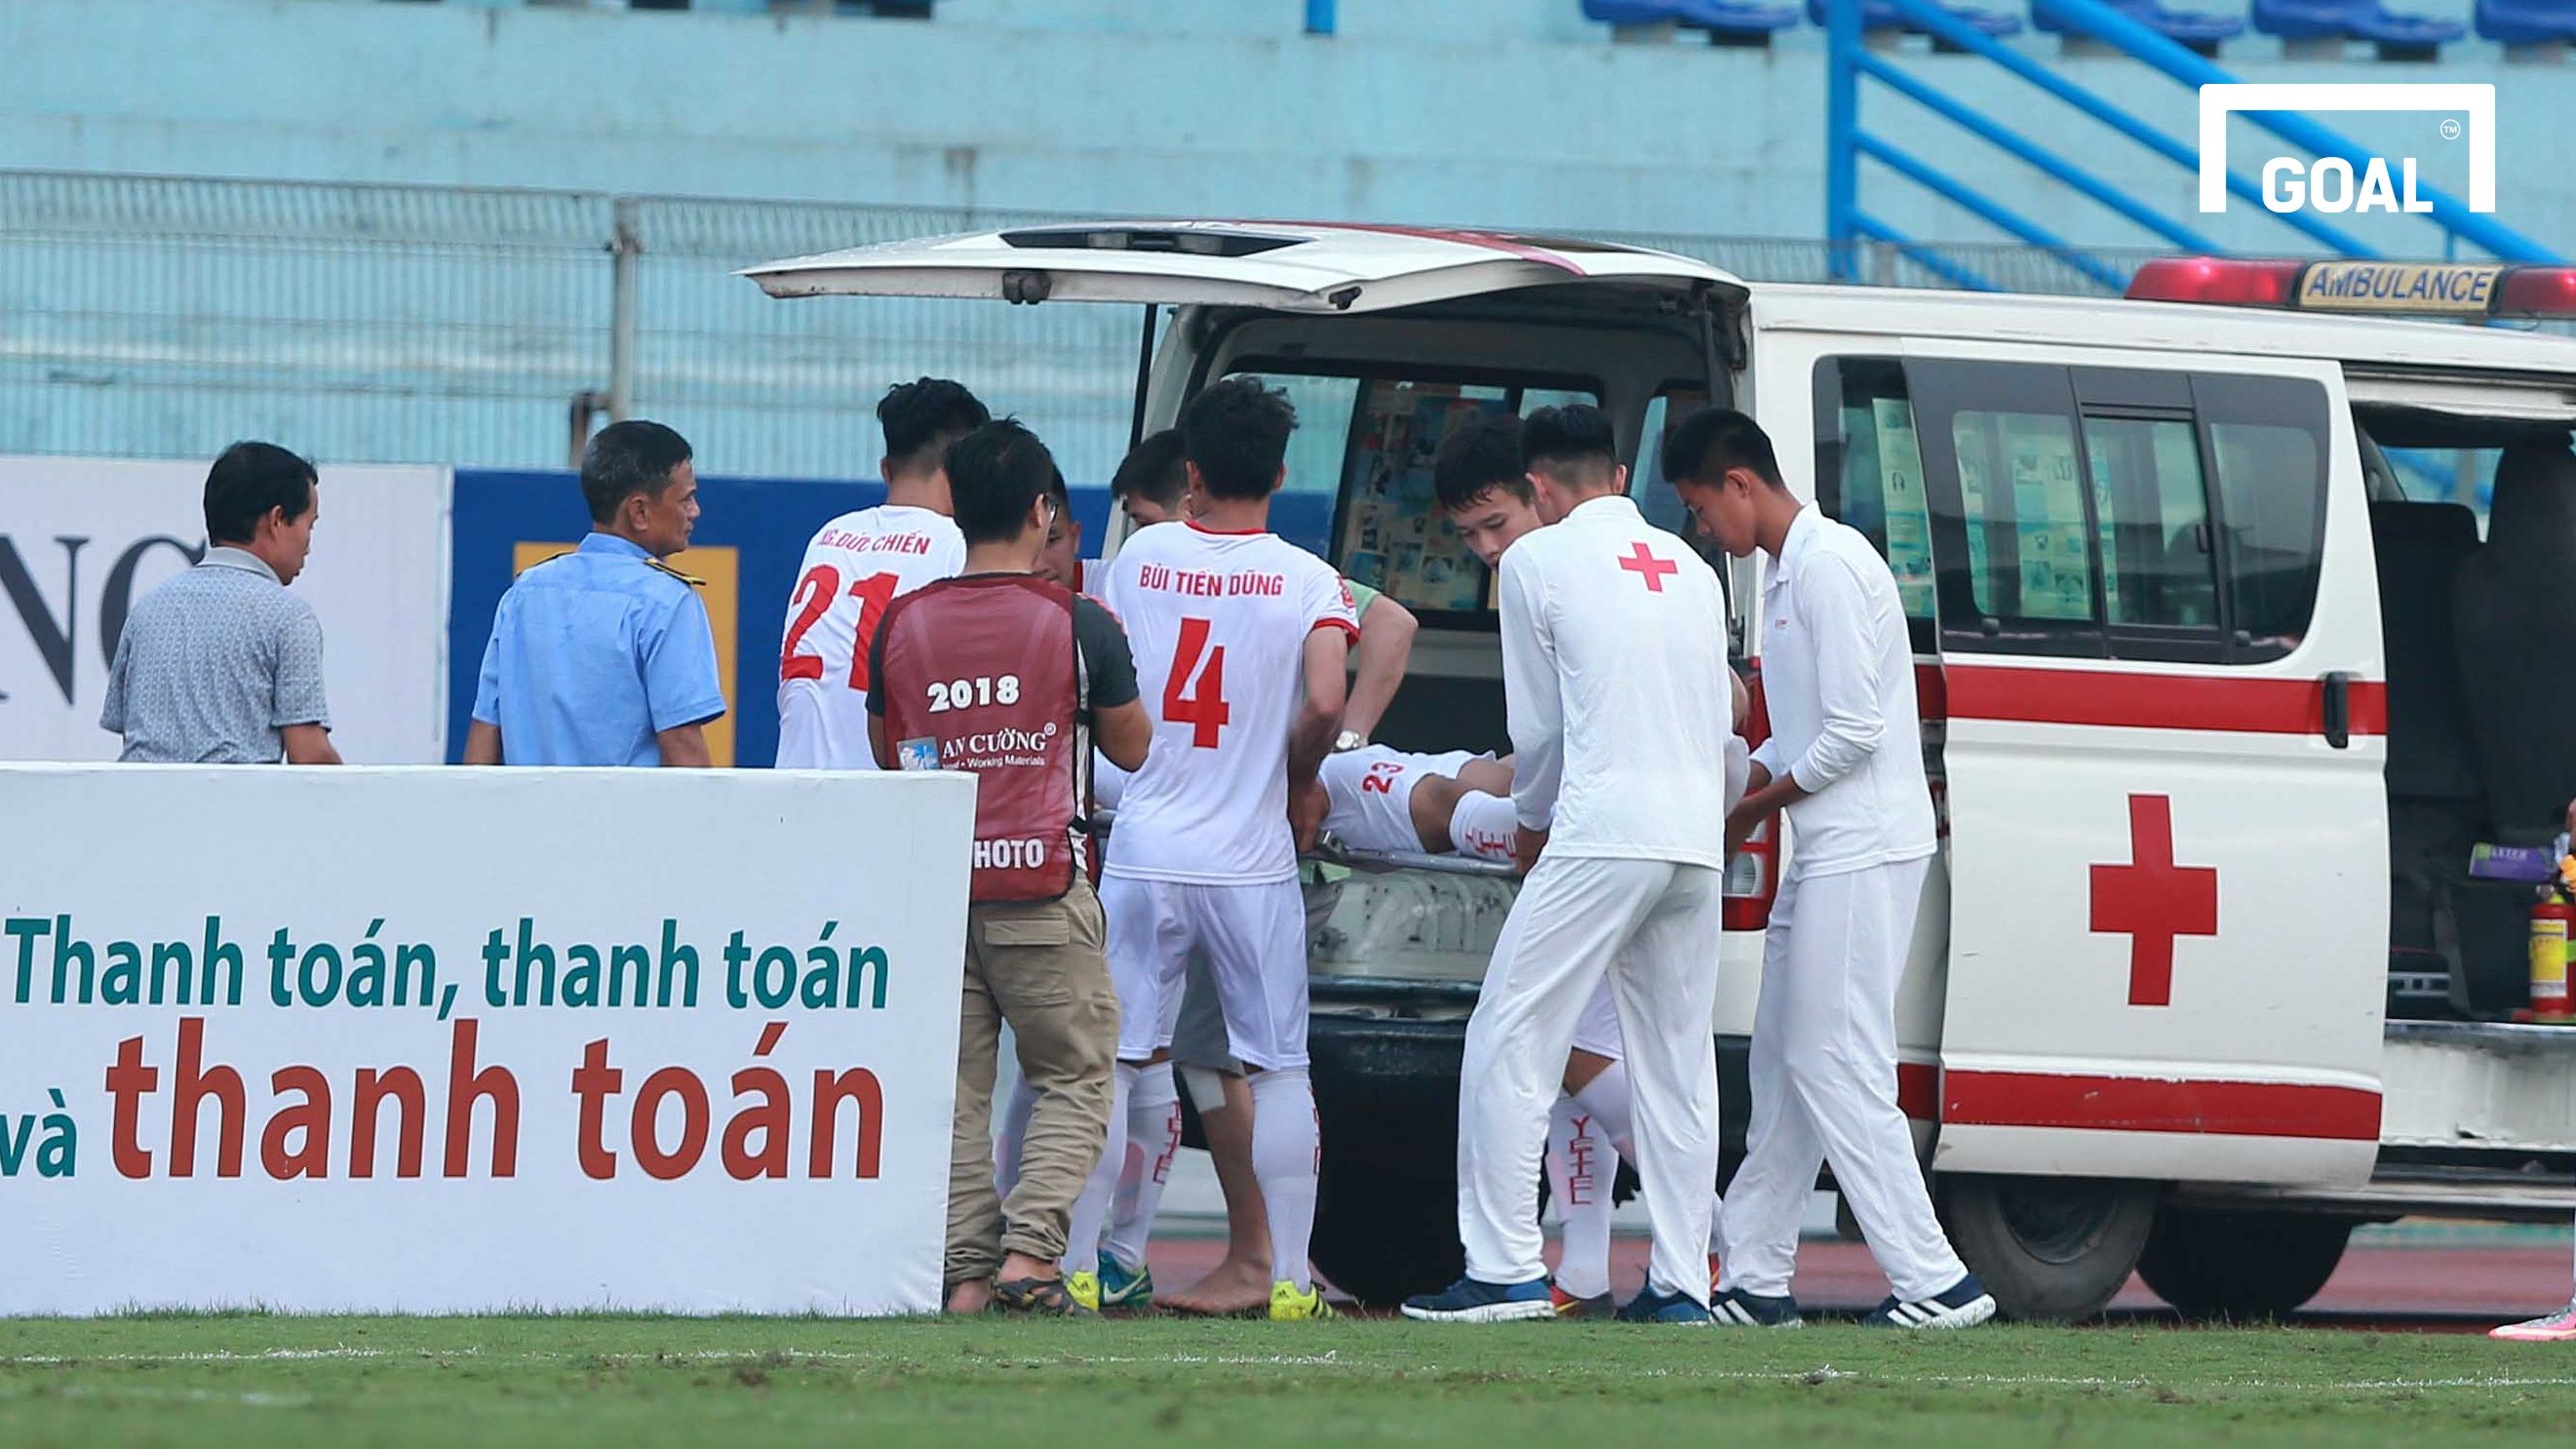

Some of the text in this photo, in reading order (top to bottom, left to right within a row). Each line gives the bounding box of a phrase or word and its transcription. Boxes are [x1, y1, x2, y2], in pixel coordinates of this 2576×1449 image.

[2307, 265, 2493, 302] AMBULANCE
[781, 564, 901, 691] 21
[927, 675, 1021, 713] 2018
[1162, 616, 1229, 749] 4
[942, 736, 966, 759] AN
[1362, 762, 1404, 795] 23
[973, 838, 1045, 869] HOTO
[4, 915, 888, 1021] Thanh toán, thanh toán
[0, 1017, 882, 1180] và thanh toán
